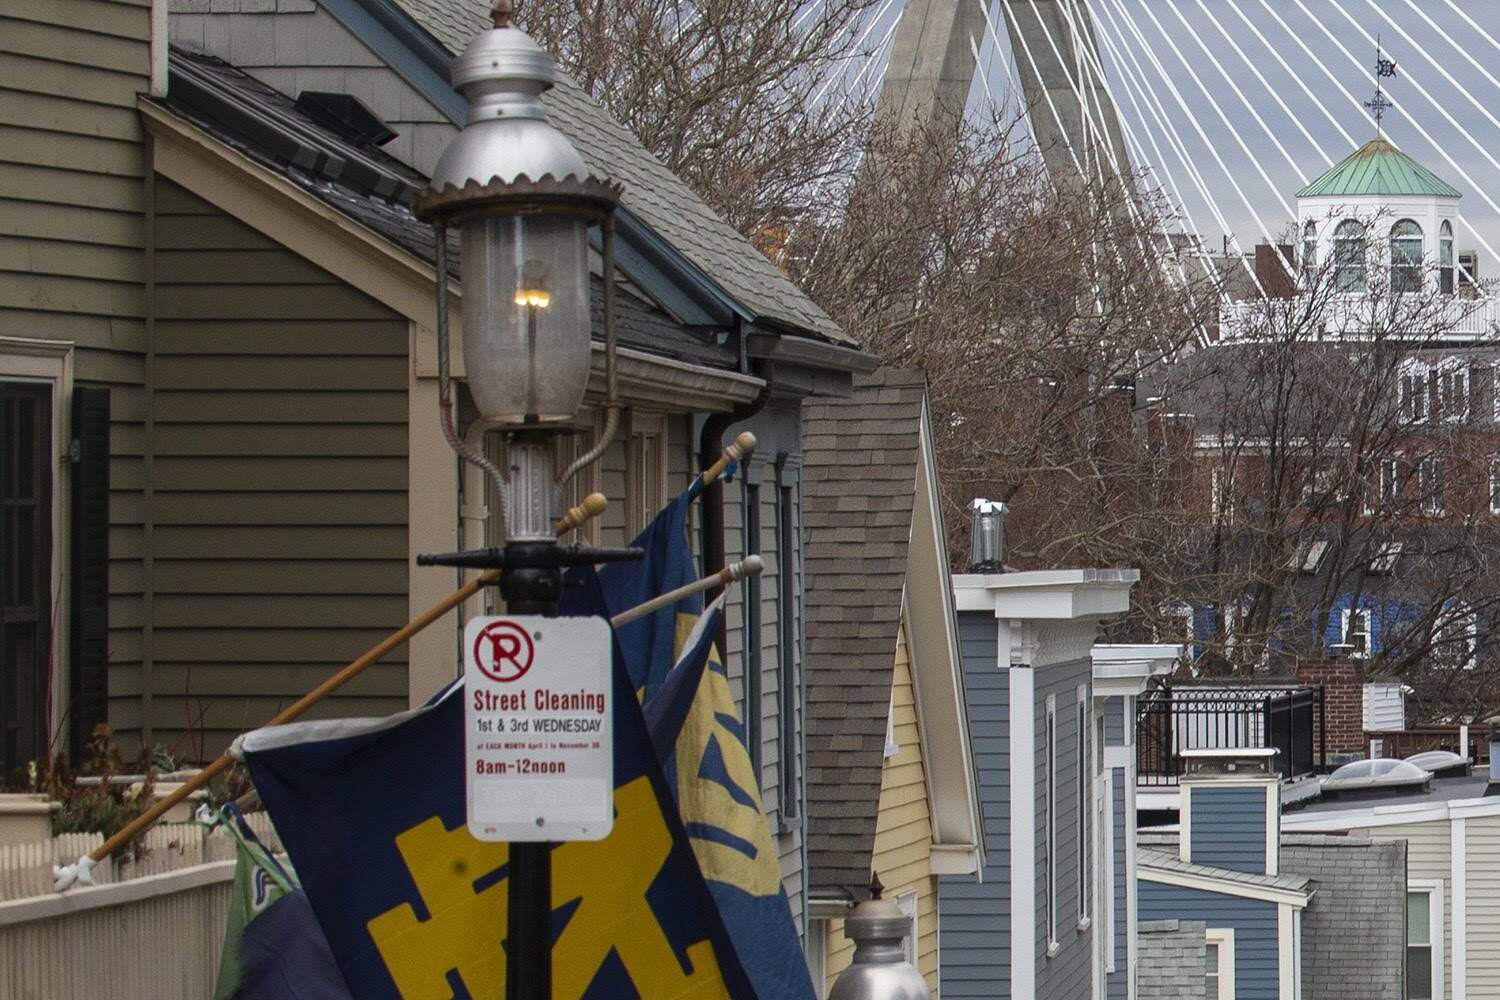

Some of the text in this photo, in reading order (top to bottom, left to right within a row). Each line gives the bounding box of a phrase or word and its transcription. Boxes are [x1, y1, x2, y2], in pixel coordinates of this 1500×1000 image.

[474, 689, 604, 714] Street Cleaning
[478, 719, 602, 733] 1st & 3rd WEDNESDAY
[477, 758, 565, 774] 8am-12noon
